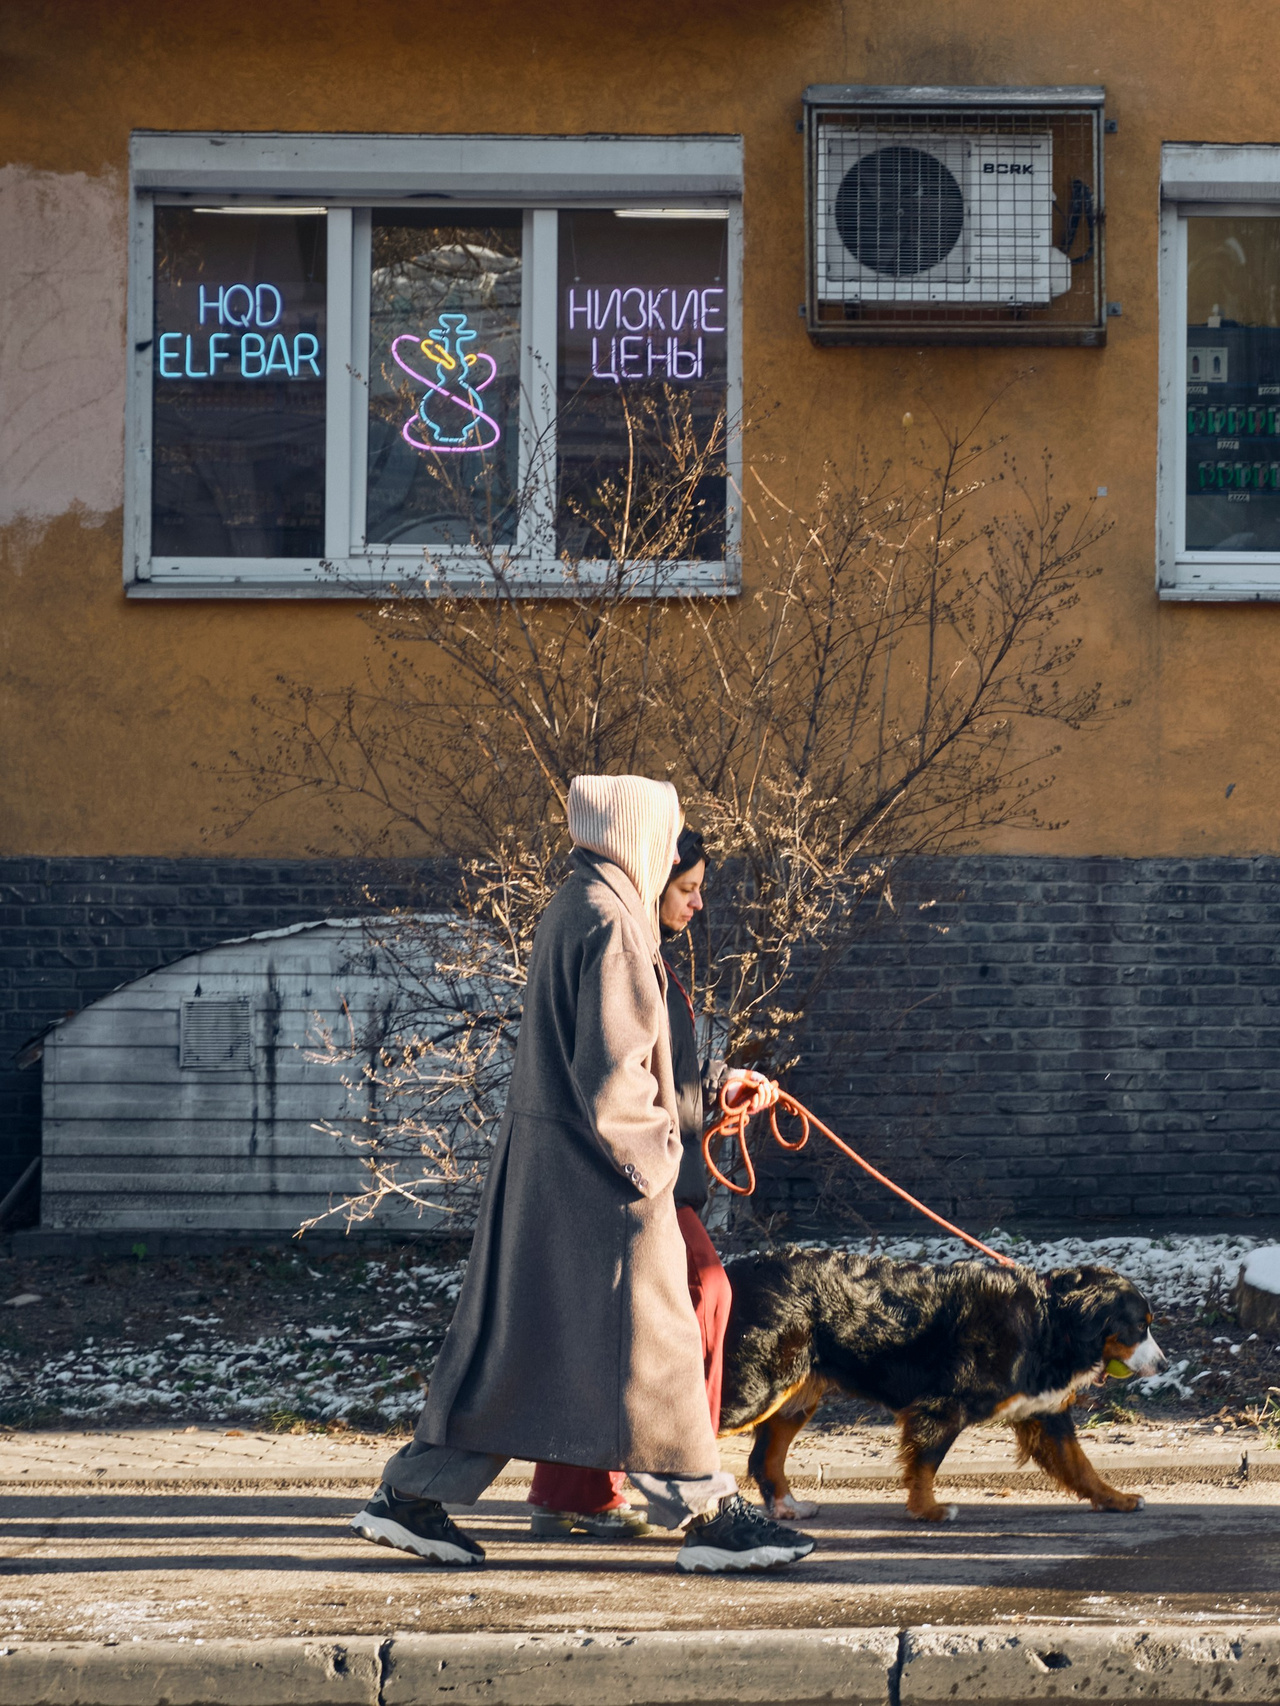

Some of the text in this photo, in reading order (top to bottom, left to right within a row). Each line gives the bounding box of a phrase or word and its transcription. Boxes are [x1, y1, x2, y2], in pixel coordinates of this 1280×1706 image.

[199, 283, 281, 327] HQD
[569, 287, 725, 332] НИЗКИЕ
[159, 332, 320, 377] ELF BAR
[591, 336, 703, 384] ЦЕНЫ
